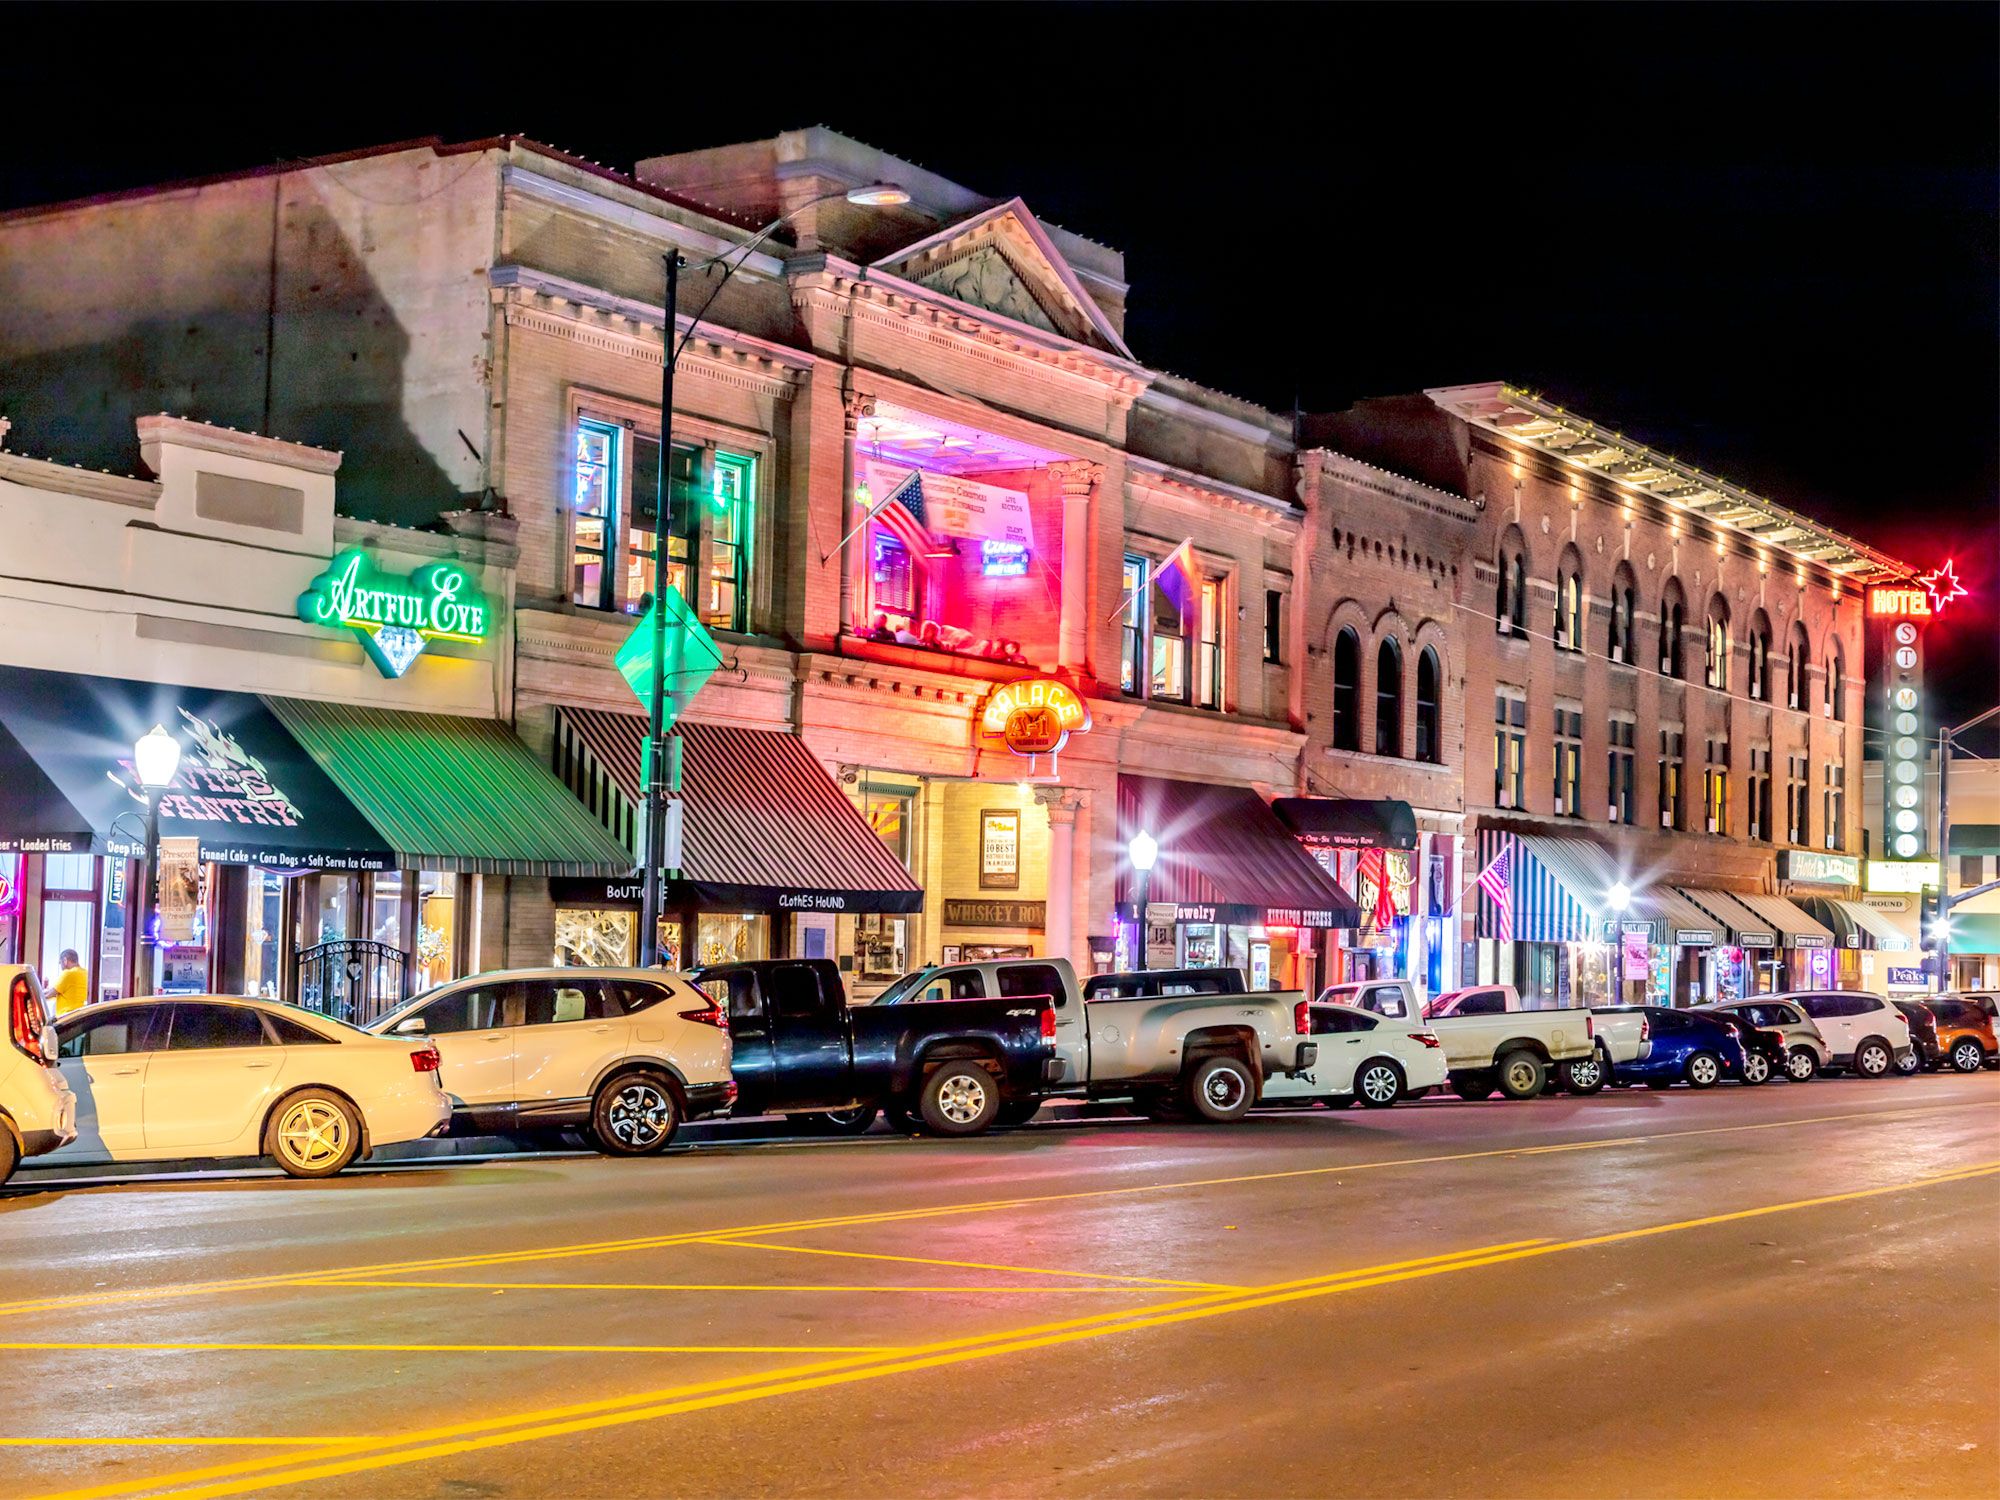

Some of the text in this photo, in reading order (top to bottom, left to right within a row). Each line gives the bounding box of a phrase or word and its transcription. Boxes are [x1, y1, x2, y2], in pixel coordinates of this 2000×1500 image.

[430, 567, 483, 635] EYE
[1873, 589, 1932, 615] HOTEL
[985, 684, 1080, 724] PALACE
[1008, 714, 1050, 738] A-1
[20, 838, 49, 851] Loaded
[51, 840, 72, 851] Fries
[1333, 836, 1359, 846] Whiskey
[1360, 836, 1374, 845] Row
[107, 840, 130, 857] Deep
[200, 848, 228, 862] Funnel
[229, 850, 249, 862] Cake
[259, 851, 277, 864] Corn
[279, 853, 299, 867] Dogs
[308, 855, 324, 867] Soft
[325, 856, 346, 868] Serve
[347, 858, 359, 869] Ice
[360, 858, 383, 869] Cream
[948, 905, 1014, 923] WHISKEY
[1892, 968, 1925, 982] Peaks
